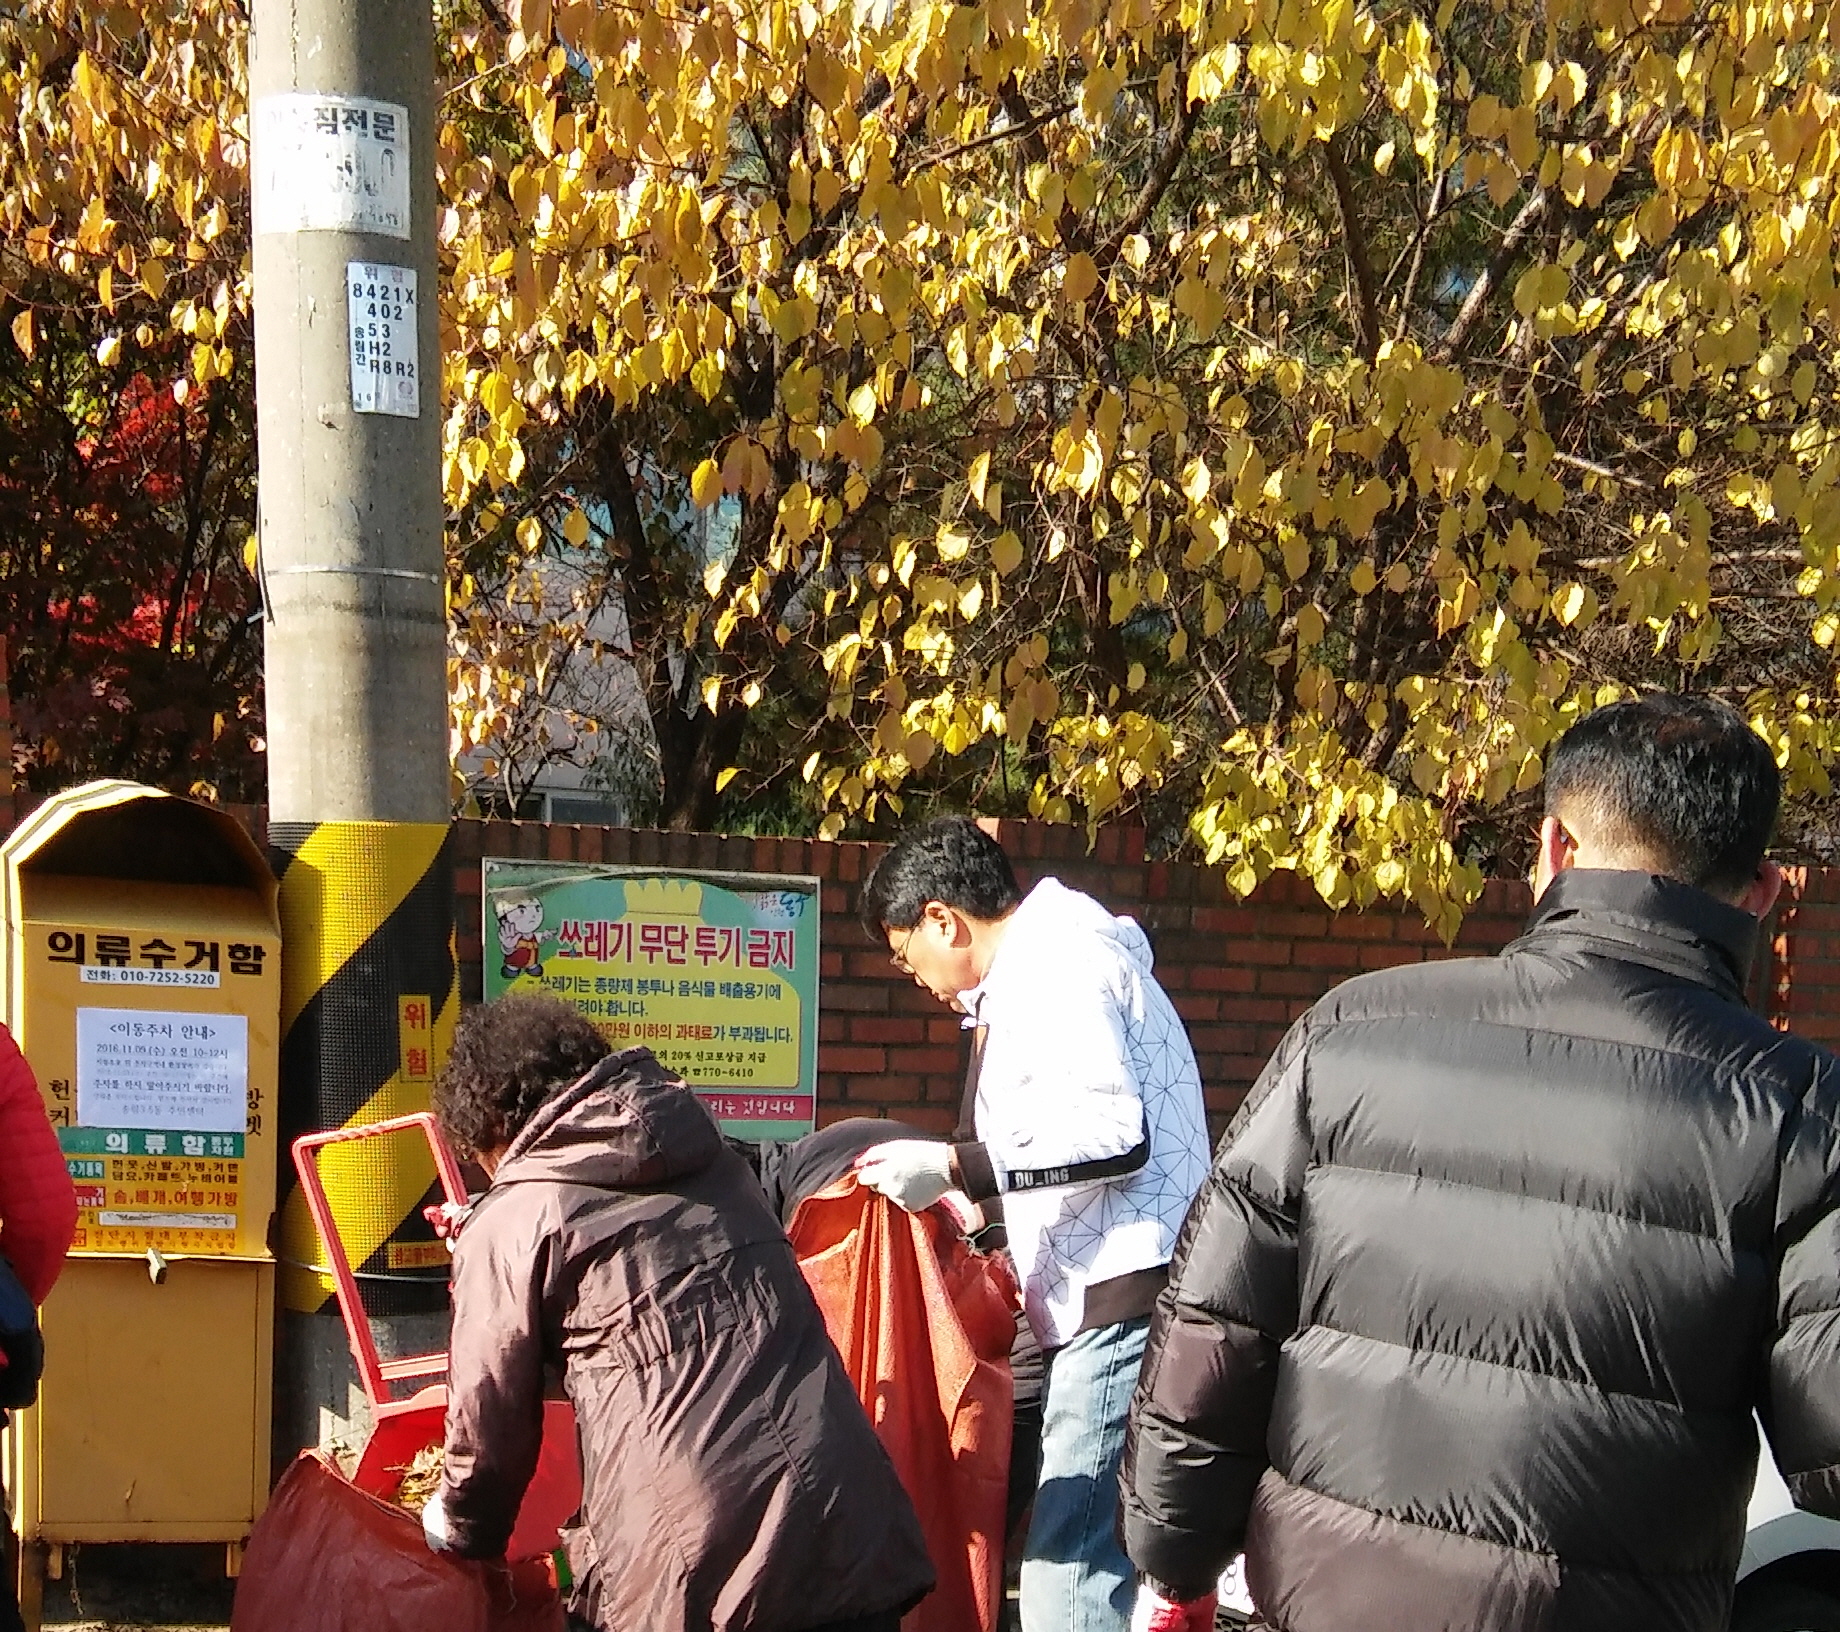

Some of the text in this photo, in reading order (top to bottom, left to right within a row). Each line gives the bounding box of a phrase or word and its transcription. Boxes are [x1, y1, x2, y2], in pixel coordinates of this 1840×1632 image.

[367, 303, 403, 320] 402
[368, 323, 390, 338] 53
[369, 341, 391, 357] H2
[48, 931, 266, 976] 의류수거함
[557, 920, 794, 970] 쓰레기 무단 투기 금지
[86, 968, 215, 985] 전화: 010-7252-5220
[540, 975, 781, 1000] 쓰레기는 종량제 봉투나 음식물 배출용기에
[634, 1023, 671, 1040] 이하의
[675, 1024, 725, 1041] 과태료가
[728, 1026, 793, 1043] 부과됩니다.
[671, 1050, 692, 1061] 20%
[695, 1051, 744, 1062] 신고포상금
[748, 1052, 767, 1063] 지급
